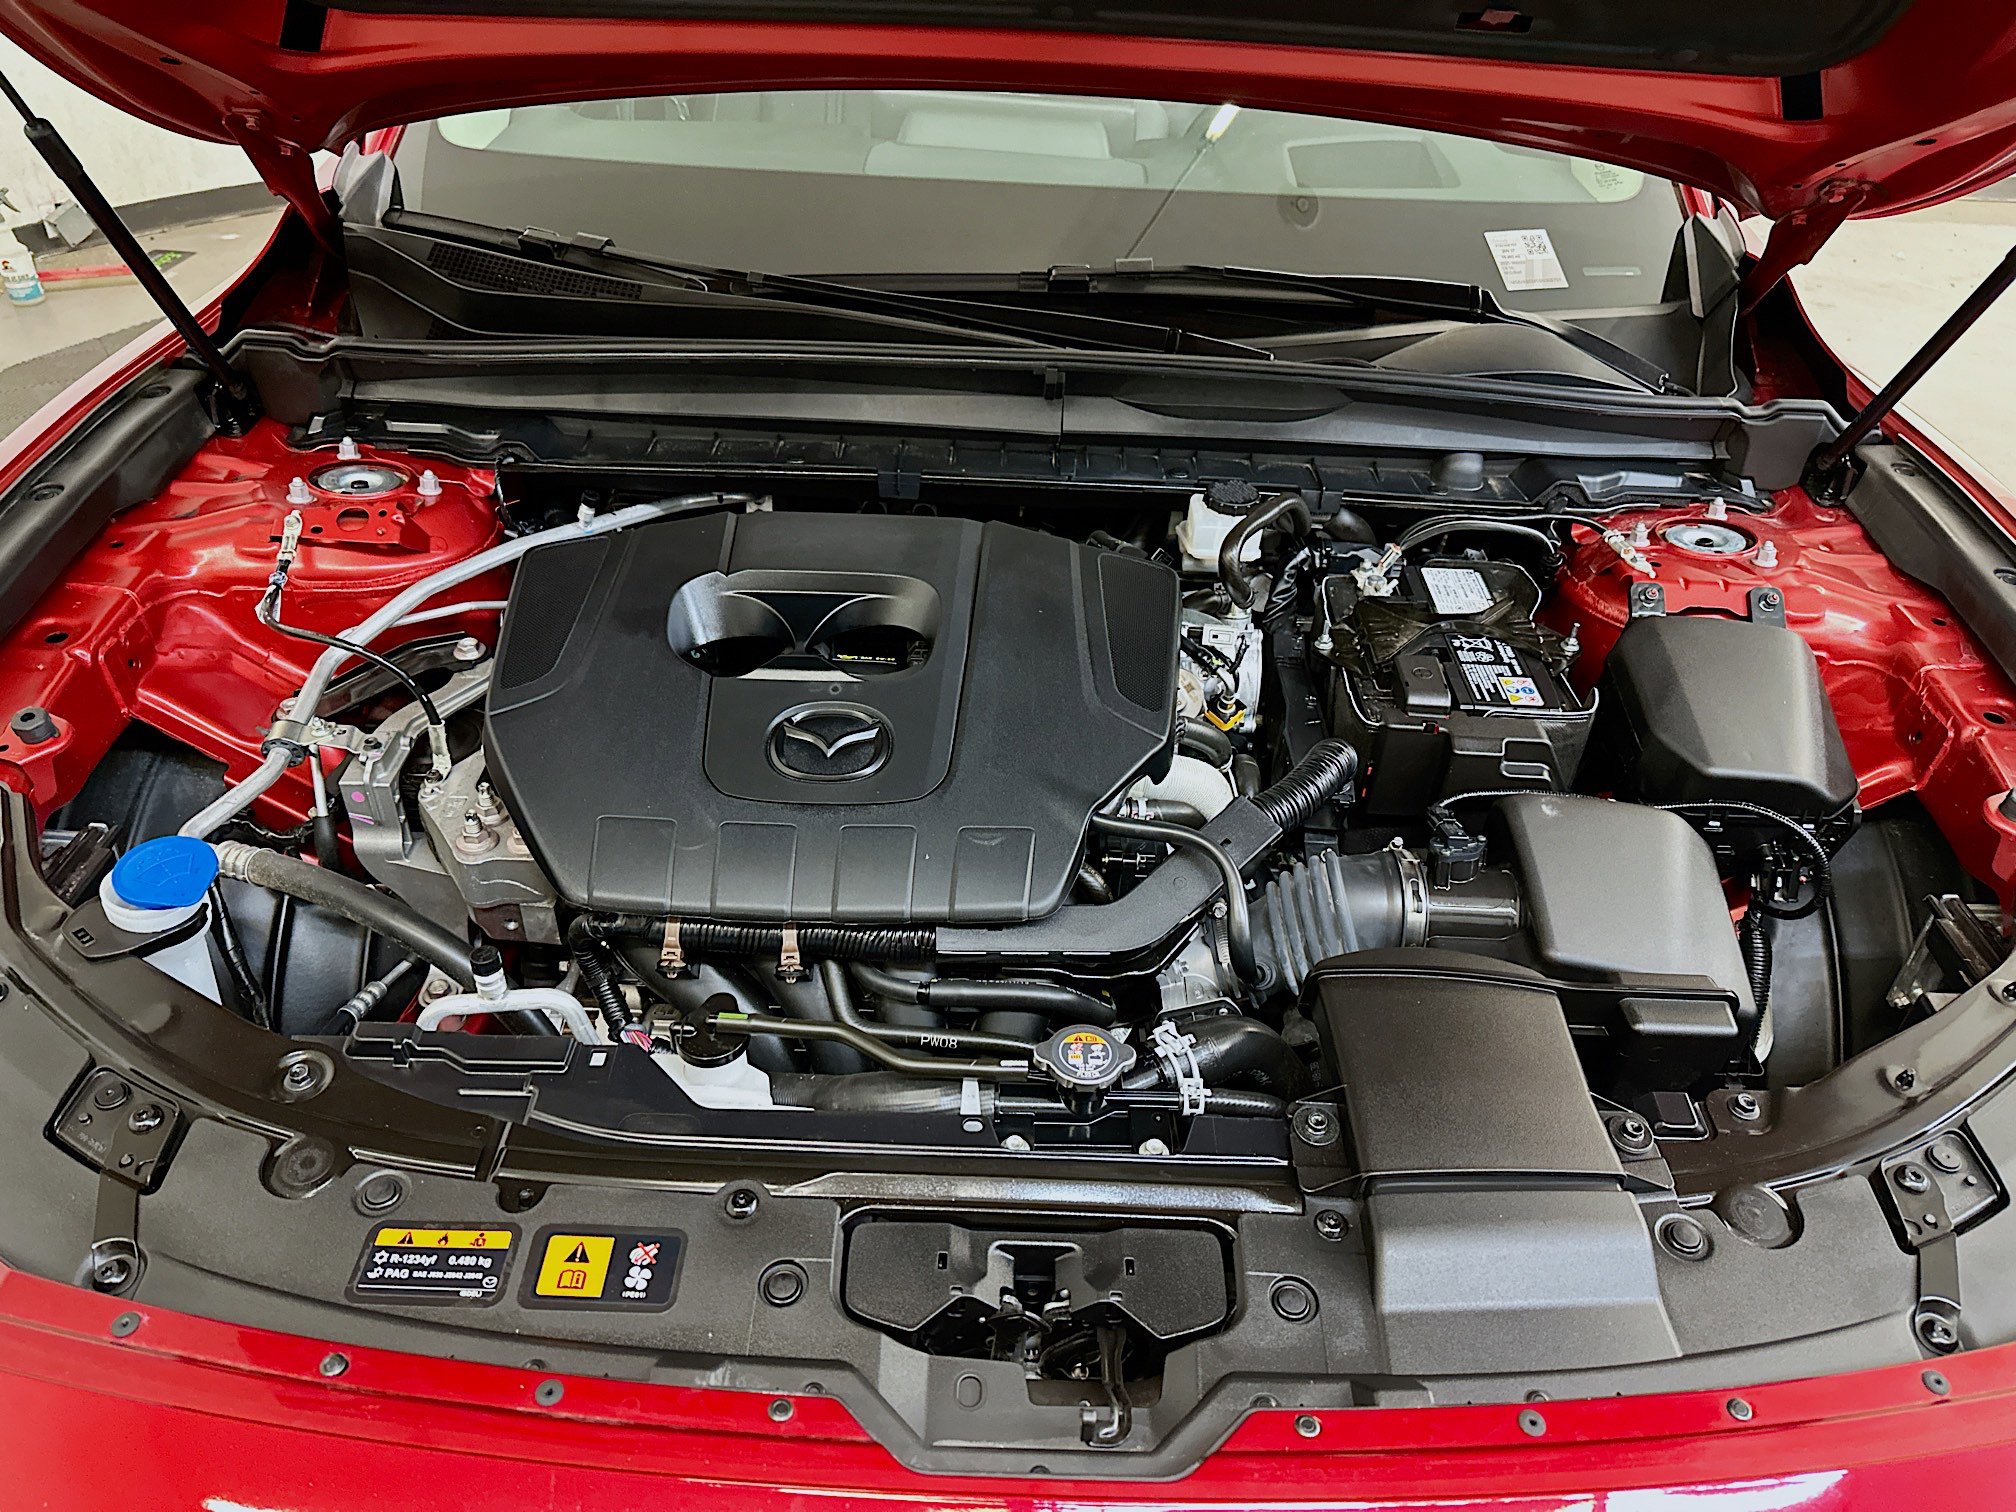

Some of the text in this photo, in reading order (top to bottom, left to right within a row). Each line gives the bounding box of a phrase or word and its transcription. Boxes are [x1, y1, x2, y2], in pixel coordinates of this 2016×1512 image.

[920, 1033, 958, 1049] PW08
[389, 1253, 438, 1267] R-1234yf
[478, 1256, 492, 1268] kg
[384, 1268, 410, 1279] PAG
